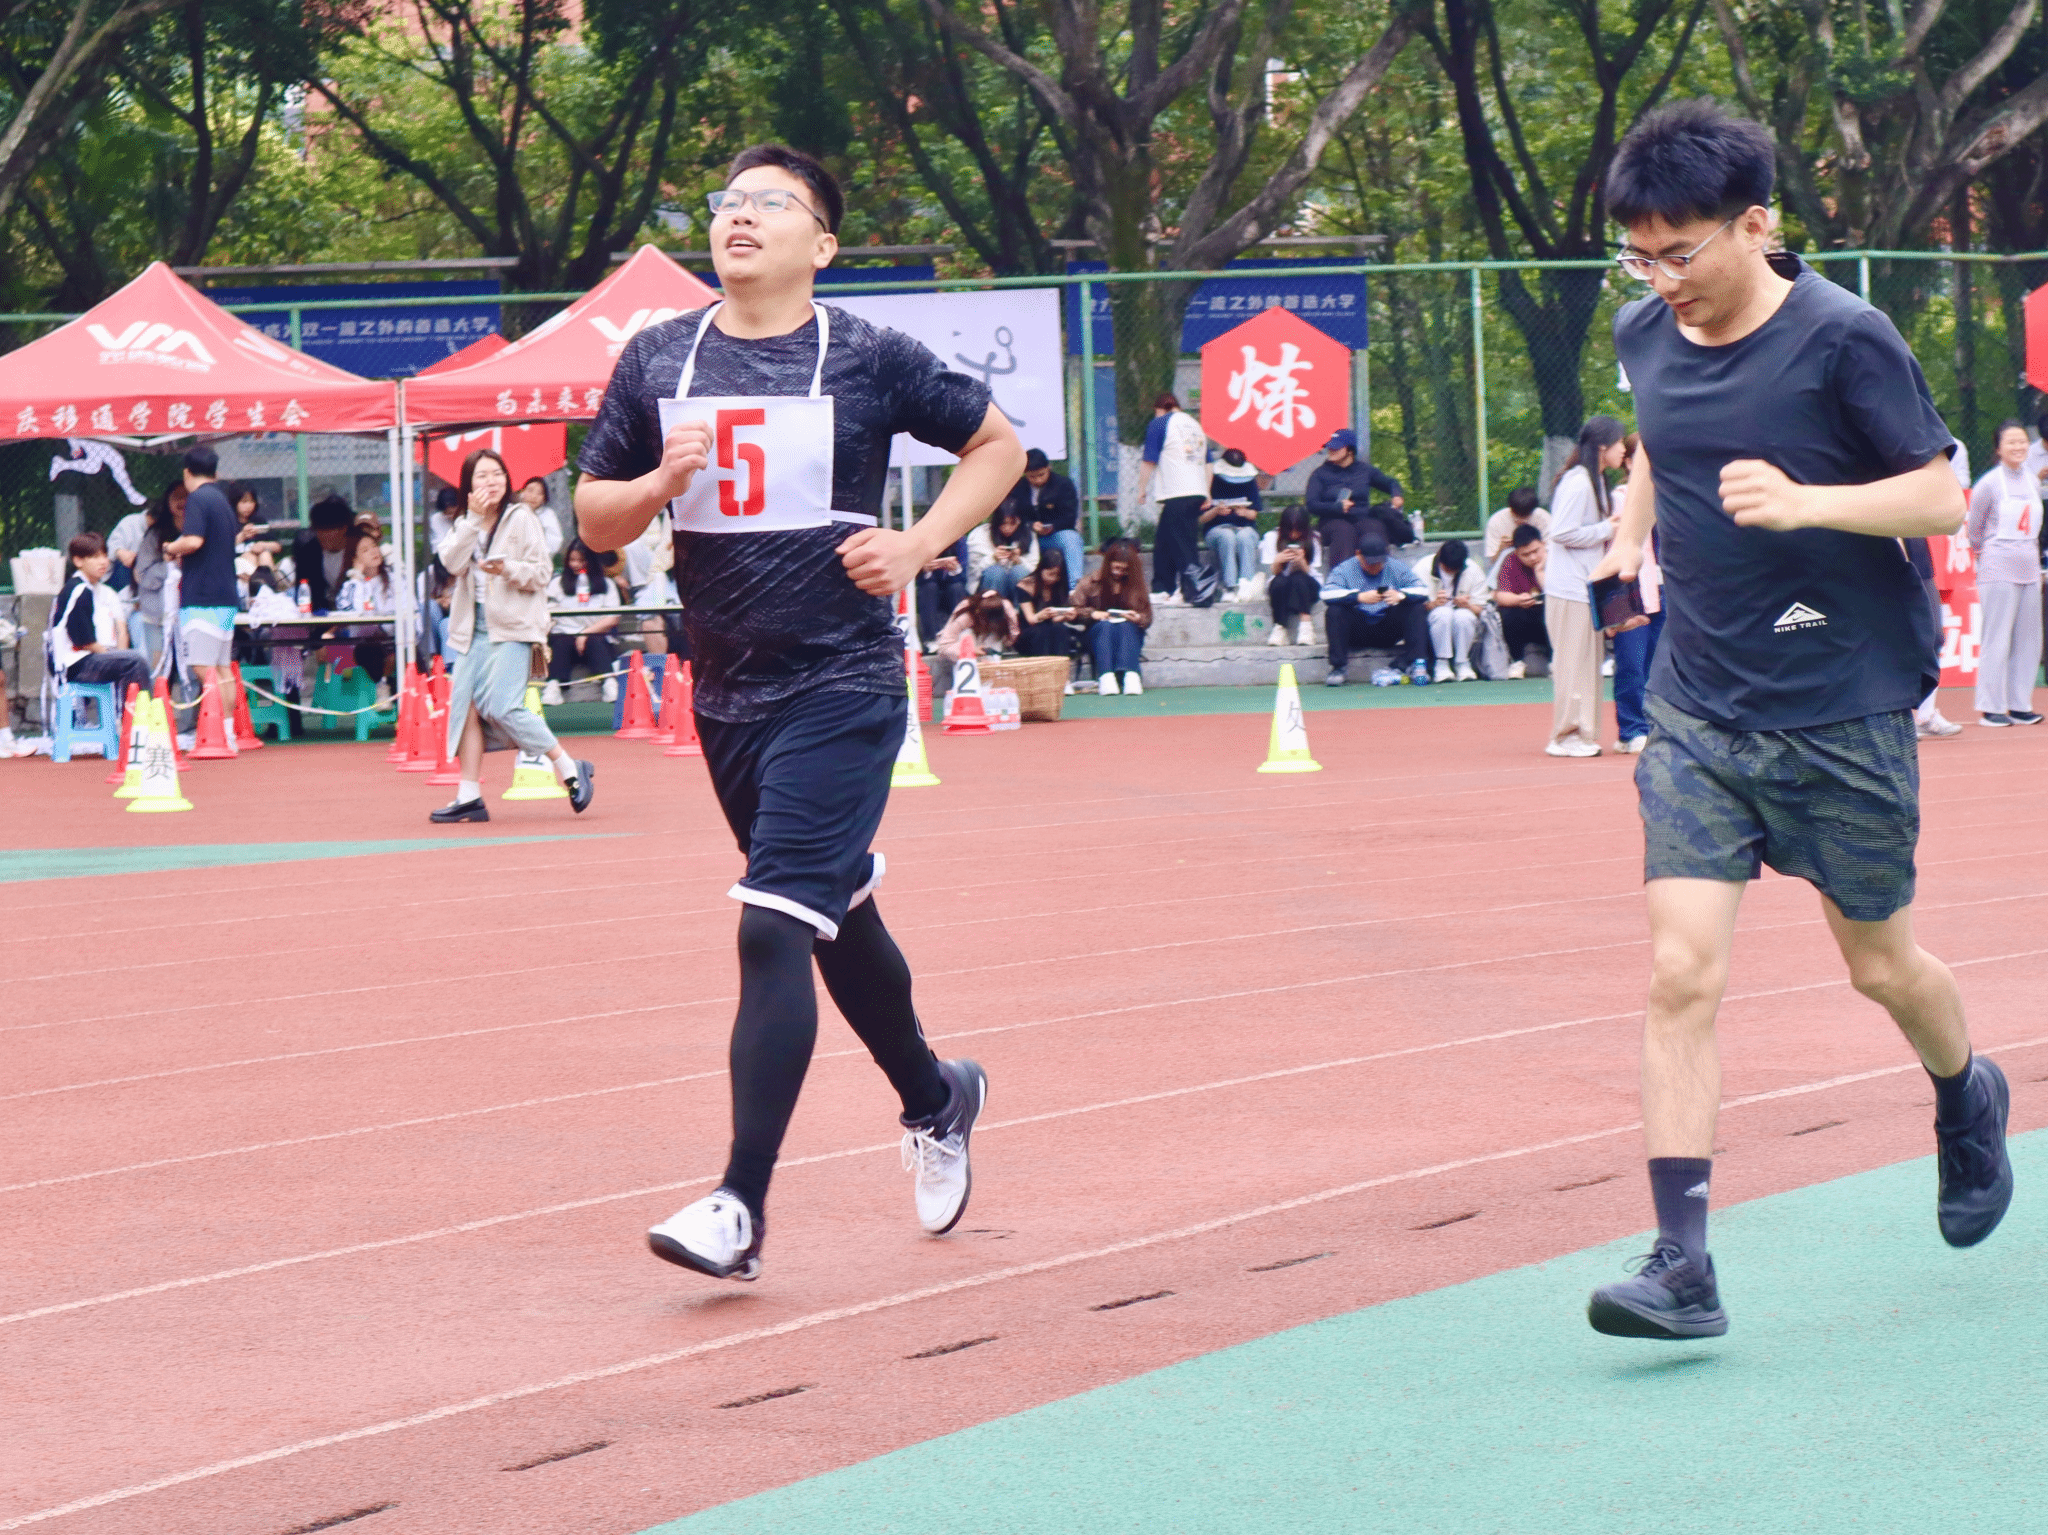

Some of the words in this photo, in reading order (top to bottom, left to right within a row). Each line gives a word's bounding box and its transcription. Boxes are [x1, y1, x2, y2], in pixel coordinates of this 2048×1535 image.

[1227, 342, 1316, 438] 炼
[716, 408, 765, 516] 5
[2017, 504, 2031, 535] 4
[1774, 625, 1797, 633] NIKE
[1800, 620, 1828, 629] TRAIL
[957, 661, 976, 694] 2
[144, 744, 174, 780] 赛
